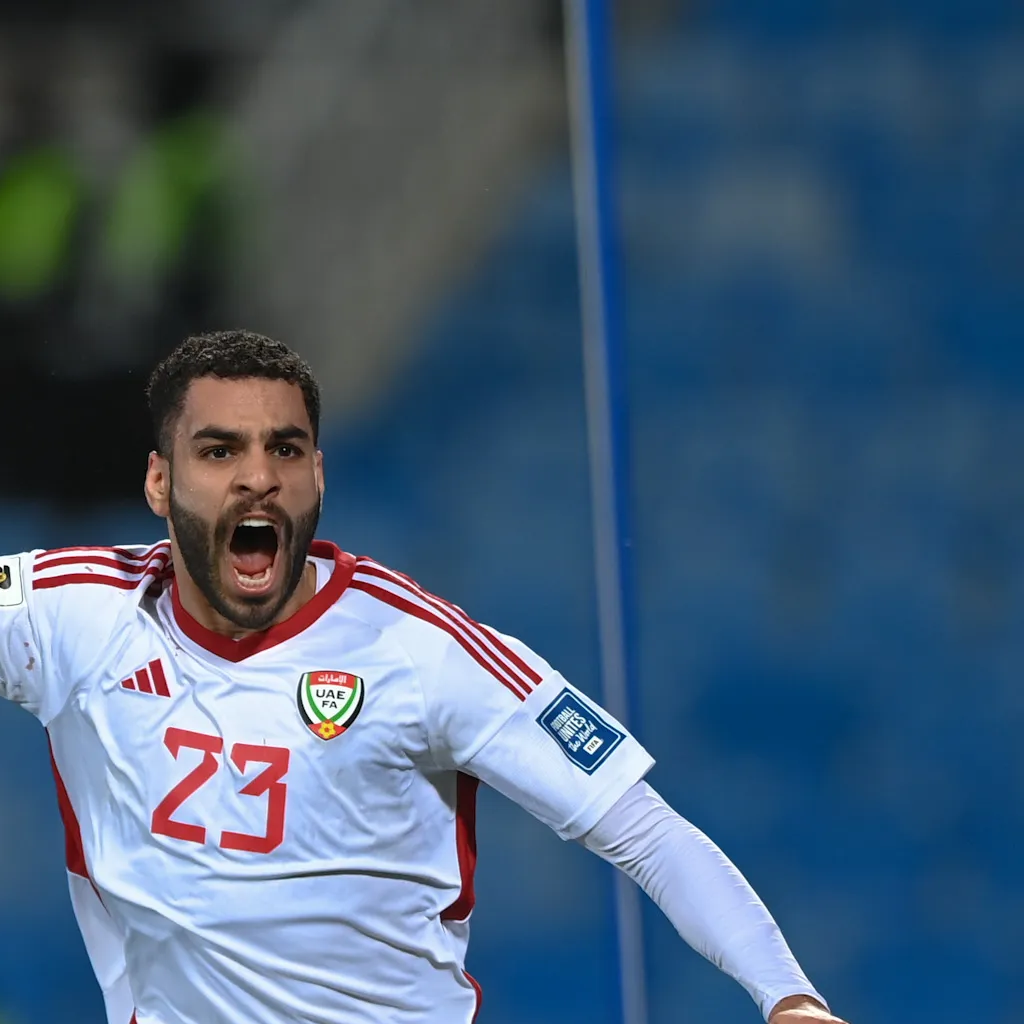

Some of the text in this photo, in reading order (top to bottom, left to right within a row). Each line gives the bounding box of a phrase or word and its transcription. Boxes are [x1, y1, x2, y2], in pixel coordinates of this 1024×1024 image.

[316, 689, 346, 700] UAE
[321, 701, 338, 709] FA
[557, 712, 586, 743] UNITES
[586, 739, 600, 752] FIFA
[151, 726, 290, 854] 23
